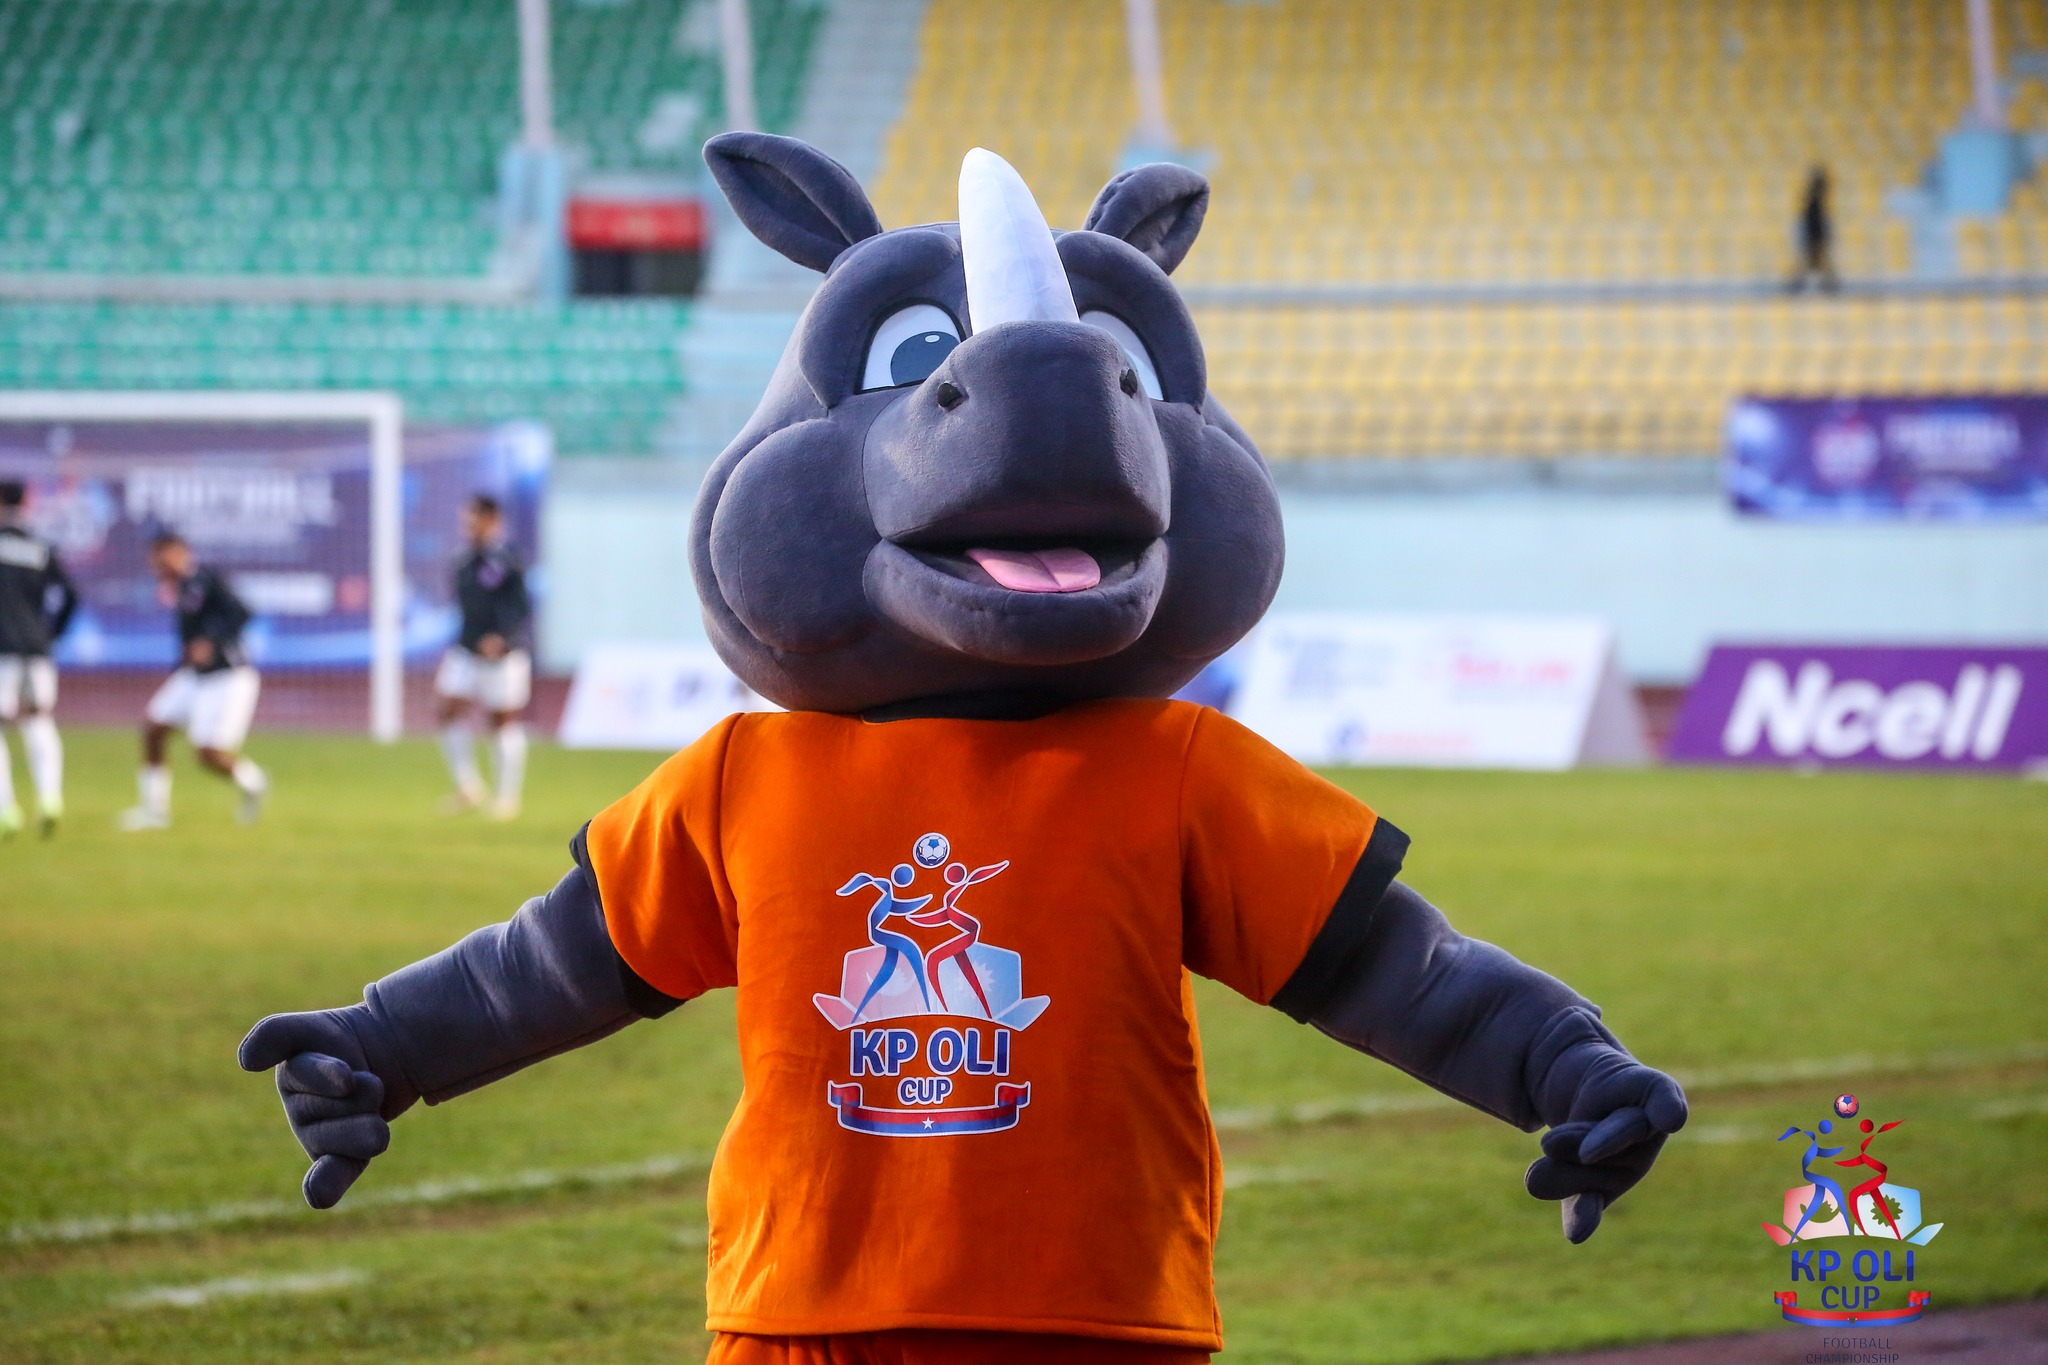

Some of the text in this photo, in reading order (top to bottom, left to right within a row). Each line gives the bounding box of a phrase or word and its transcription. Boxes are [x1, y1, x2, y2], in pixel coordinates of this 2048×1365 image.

[1723, 660, 2023, 760] Ncell
[851, 1028, 1010, 1075] KP OLI
[898, 1077, 952, 1104] CUP
